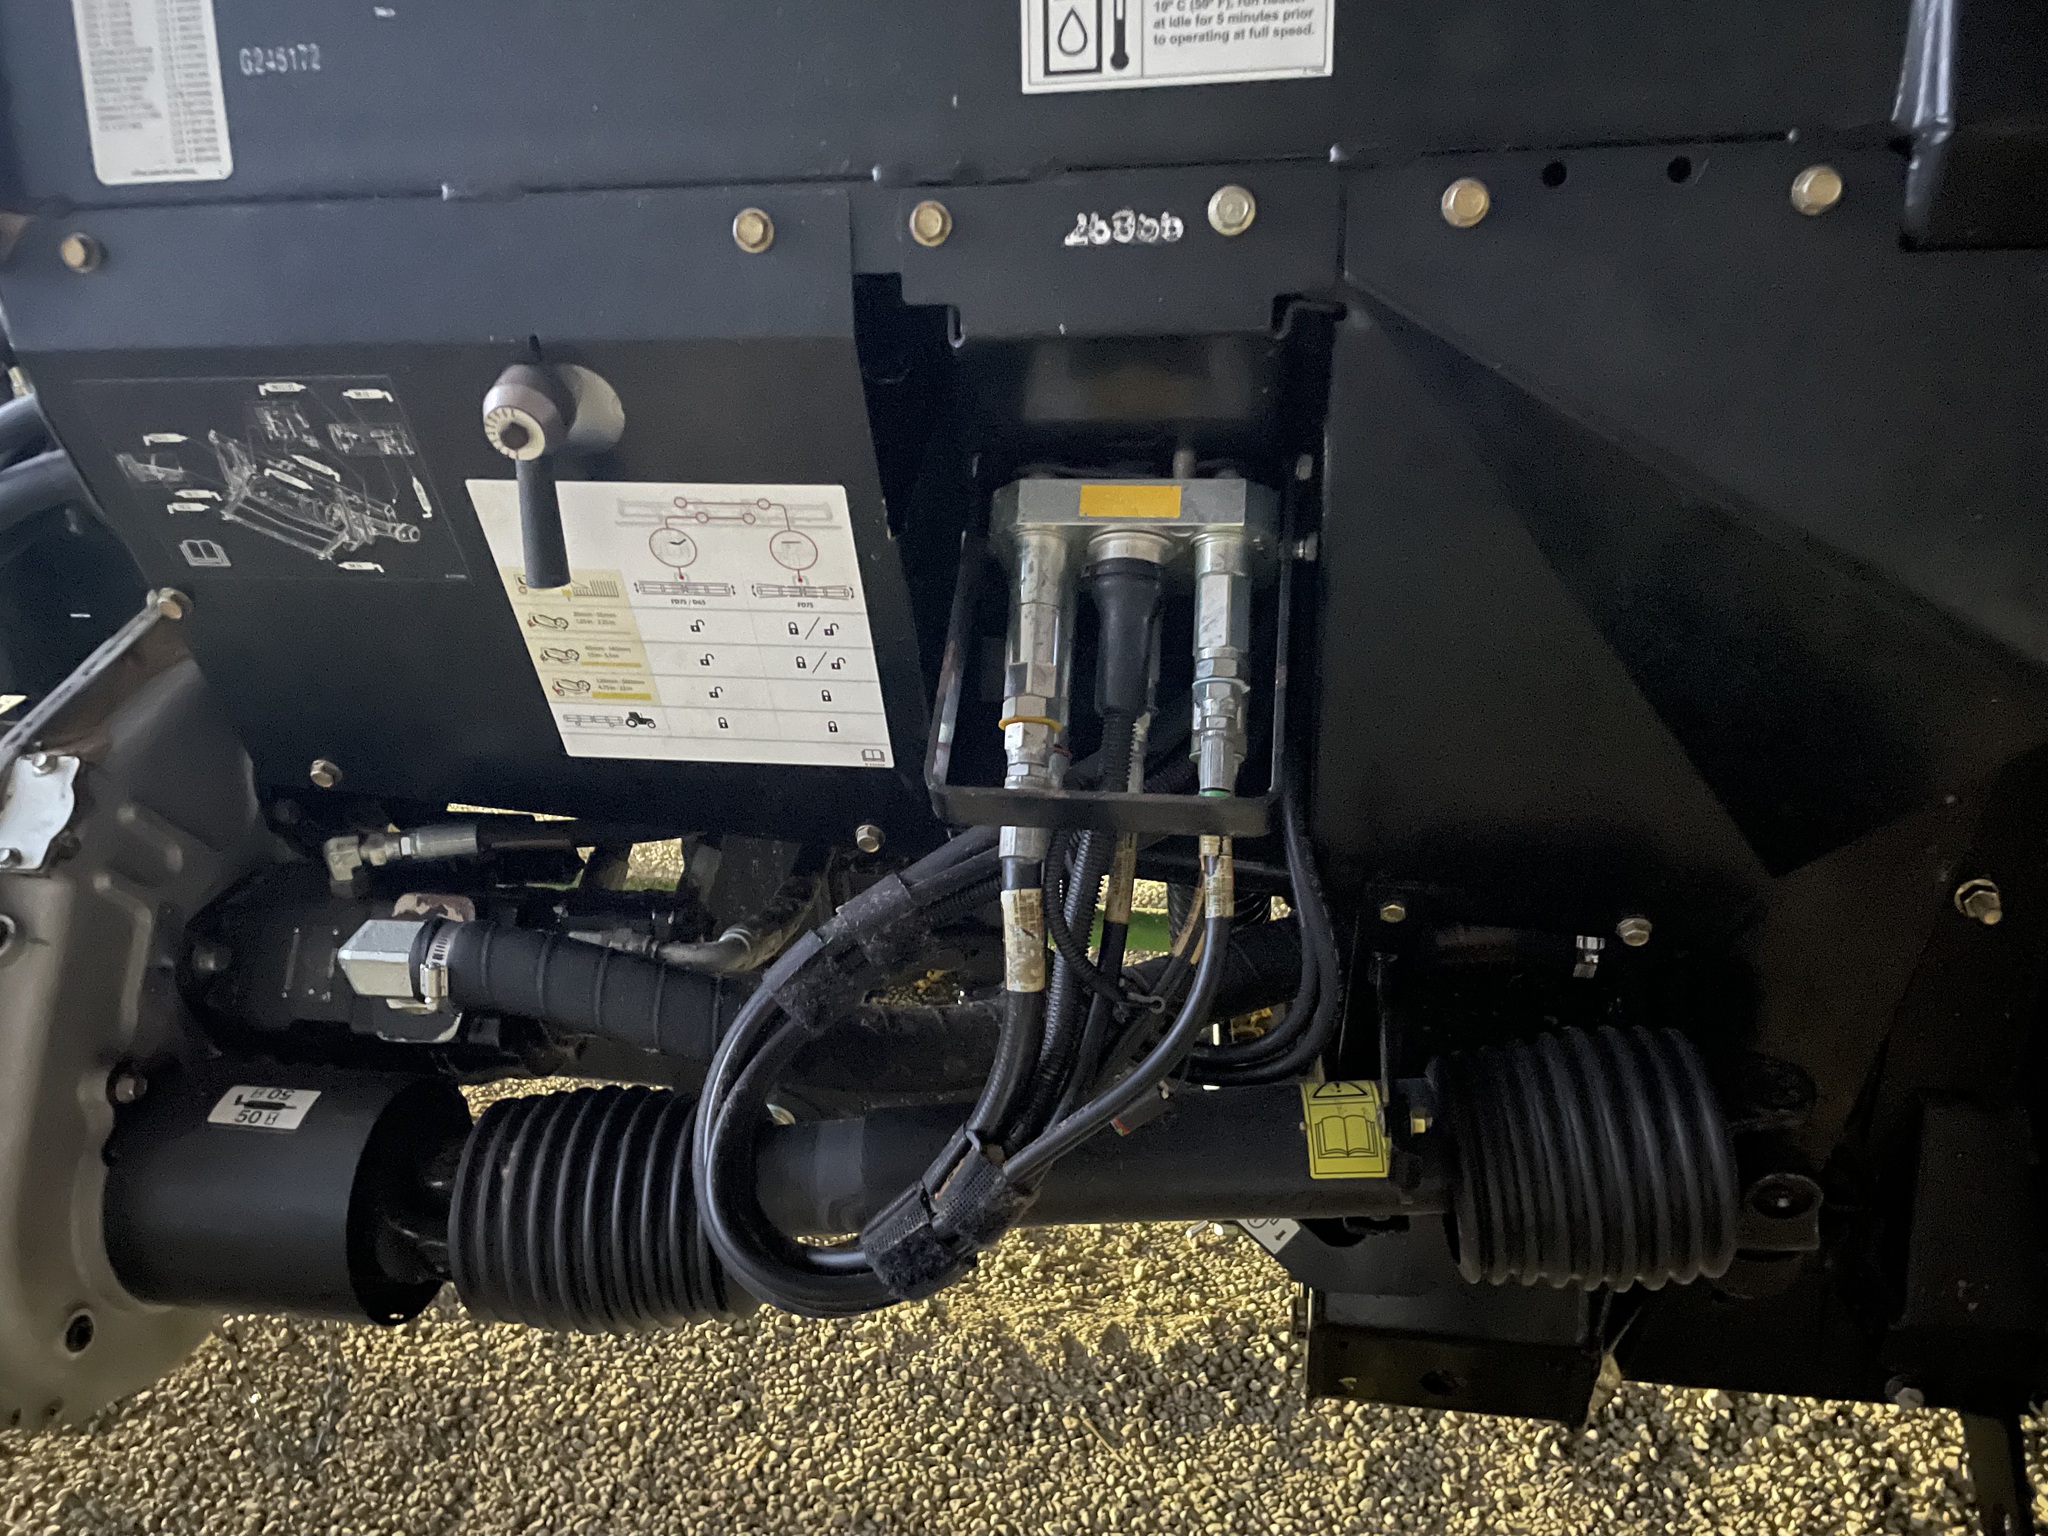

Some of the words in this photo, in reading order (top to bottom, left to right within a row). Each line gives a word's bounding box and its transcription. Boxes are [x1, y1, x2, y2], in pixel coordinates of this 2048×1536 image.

[1153, 17, 1165, 29] at
[1169, 15, 1192, 28] idle
[1195, 13, 1214, 28] for
[1216, 11, 1225, 25] 5
[1227, 10, 1279, 24] minutes
[1283, 7, 1315, 22] prior
[1153, 33, 1166, 45] to
[1170, 29, 1230, 47] operating
[1233, 29, 1245, 41] at
[1249, 26, 1270, 39] full
[1273, 23, 1315, 38] speed.
[234, 1109, 263, 1124] 50
